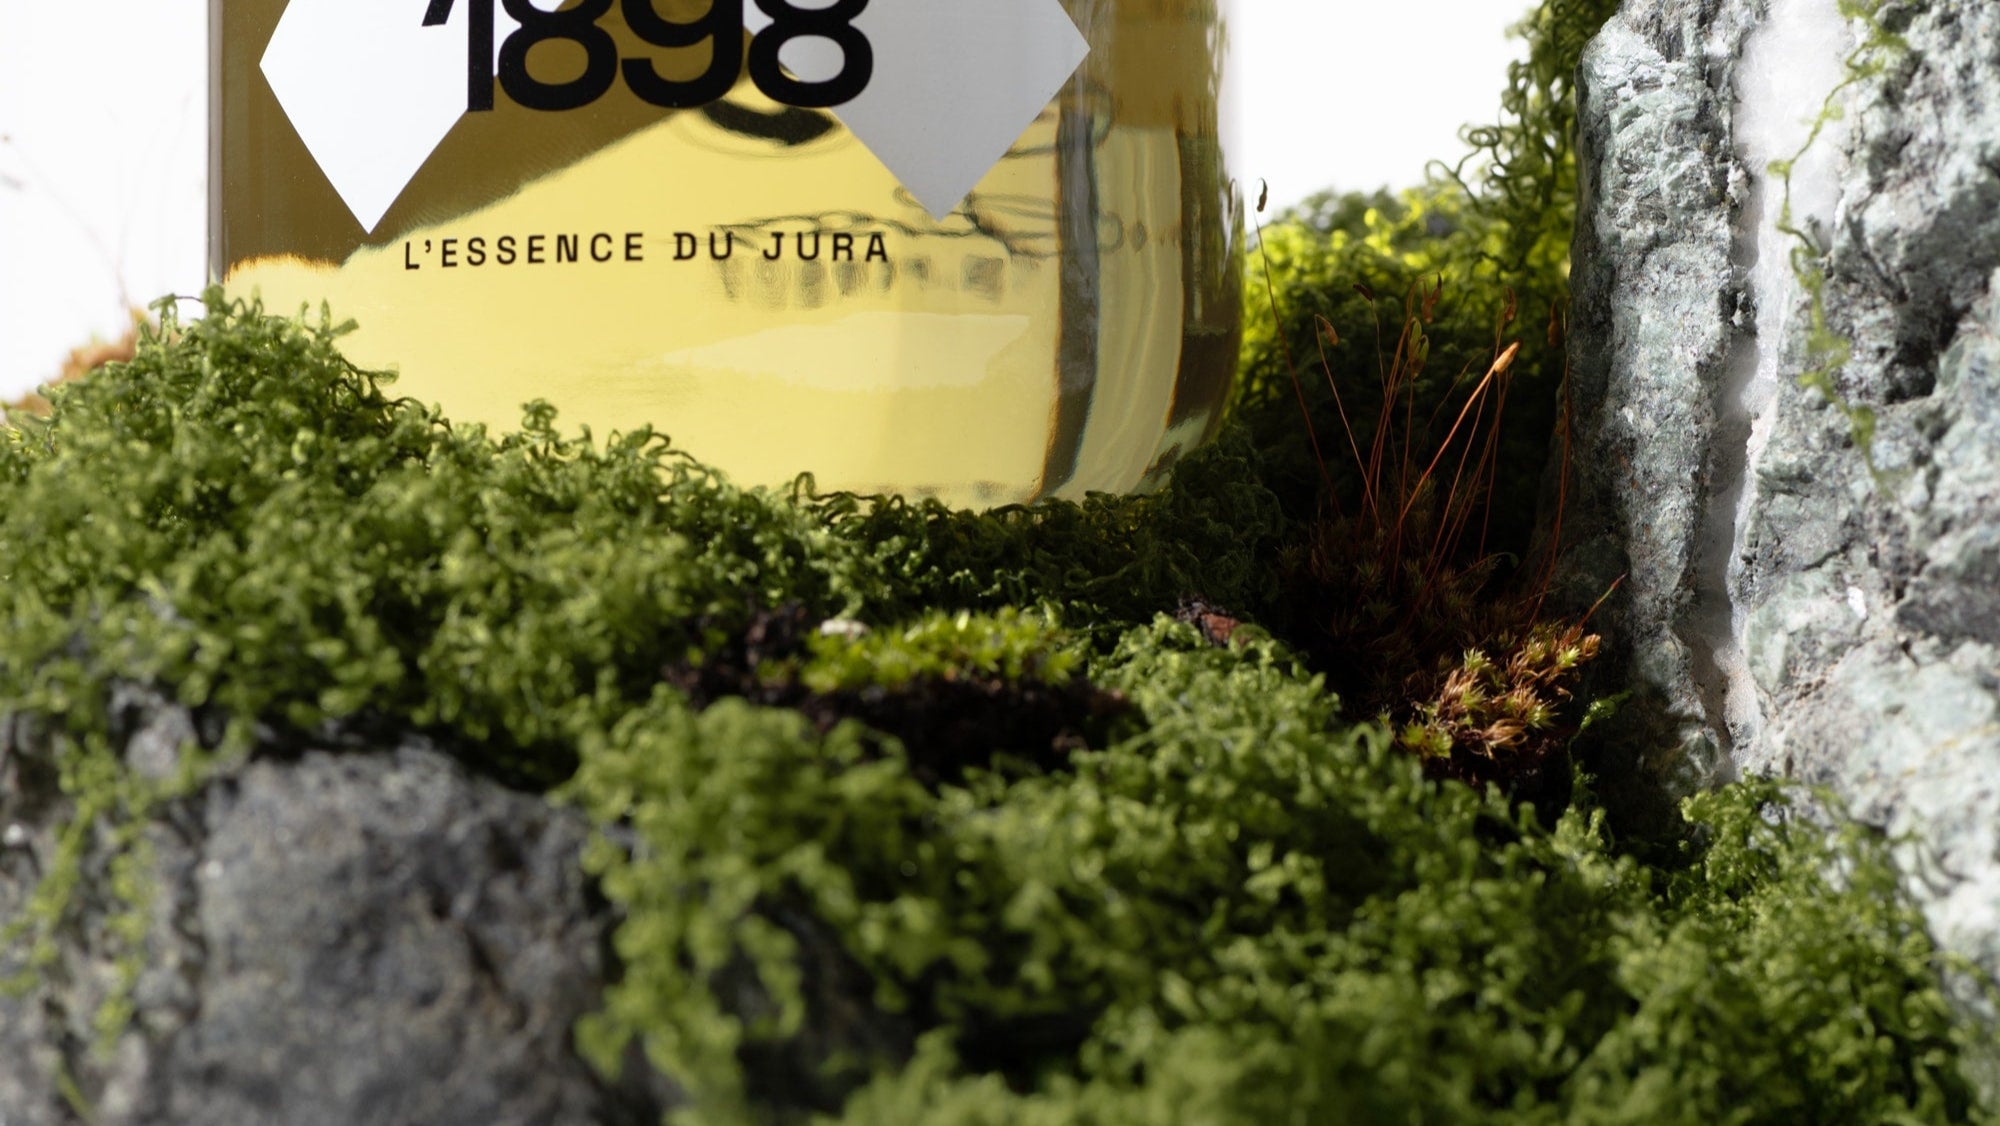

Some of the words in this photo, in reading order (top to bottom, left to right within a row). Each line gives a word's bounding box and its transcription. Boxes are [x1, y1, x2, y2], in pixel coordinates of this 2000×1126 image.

[422, 0, 874, 112] 1898
[404, 232, 644, 271] L'ESSENCE
[672, 230, 734, 261] DU
[762, 230, 889, 263] JURA
